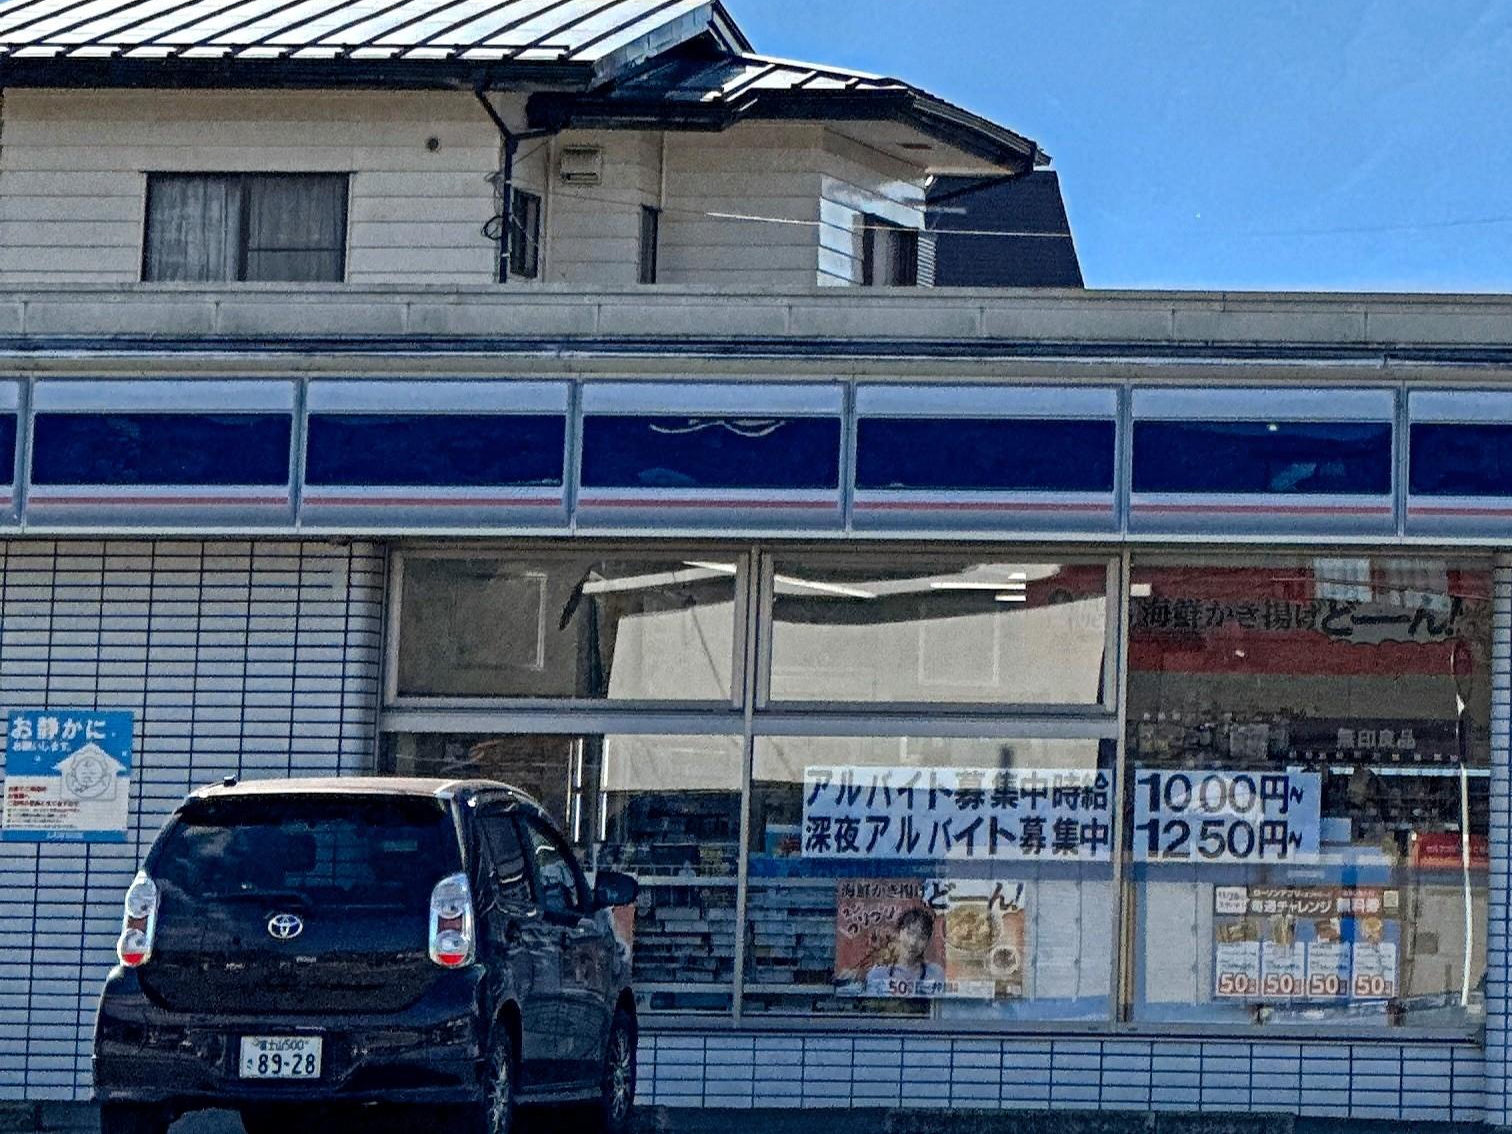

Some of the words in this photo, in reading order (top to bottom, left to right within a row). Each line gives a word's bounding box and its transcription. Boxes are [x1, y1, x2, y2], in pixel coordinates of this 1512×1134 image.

[11, 716, 107, 740] お静かに
[806, 769, 1108, 813] アルバイト募集中時給
[804, 815, 1109, 855] 深夜アルバイト募集中
[257, 1053, 316, 1075] 89-28
